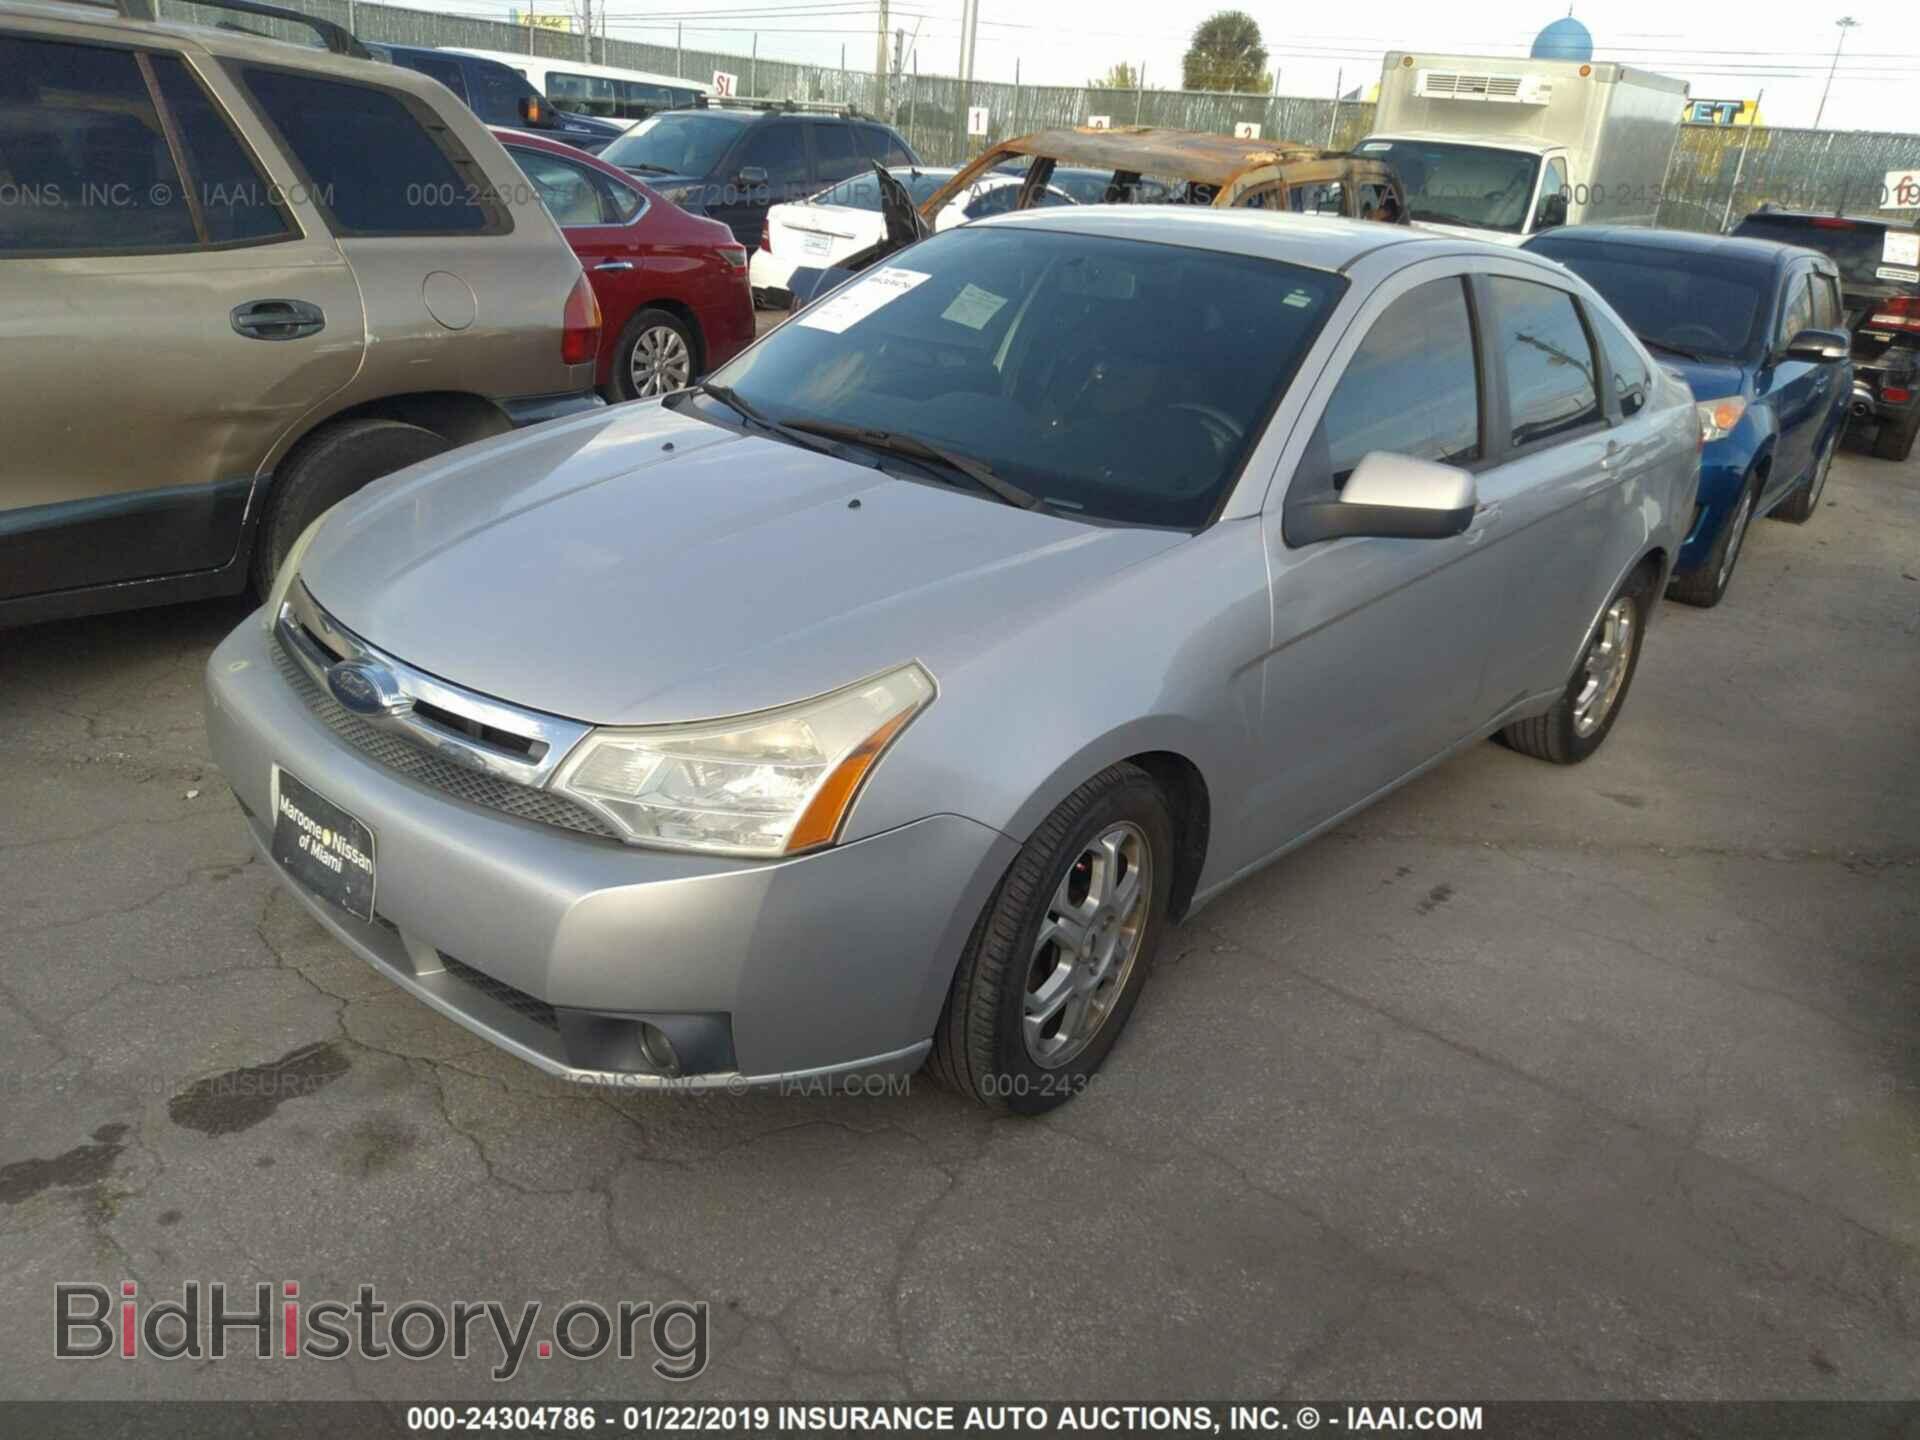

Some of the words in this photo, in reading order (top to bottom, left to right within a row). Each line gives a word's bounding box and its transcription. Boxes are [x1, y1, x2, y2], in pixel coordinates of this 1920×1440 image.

[280, 794, 322, 840] Maroone
[332, 831, 373, 875] Nissan
[299, 834, 310, 851] of
[310, 839, 343, 874] Miami
